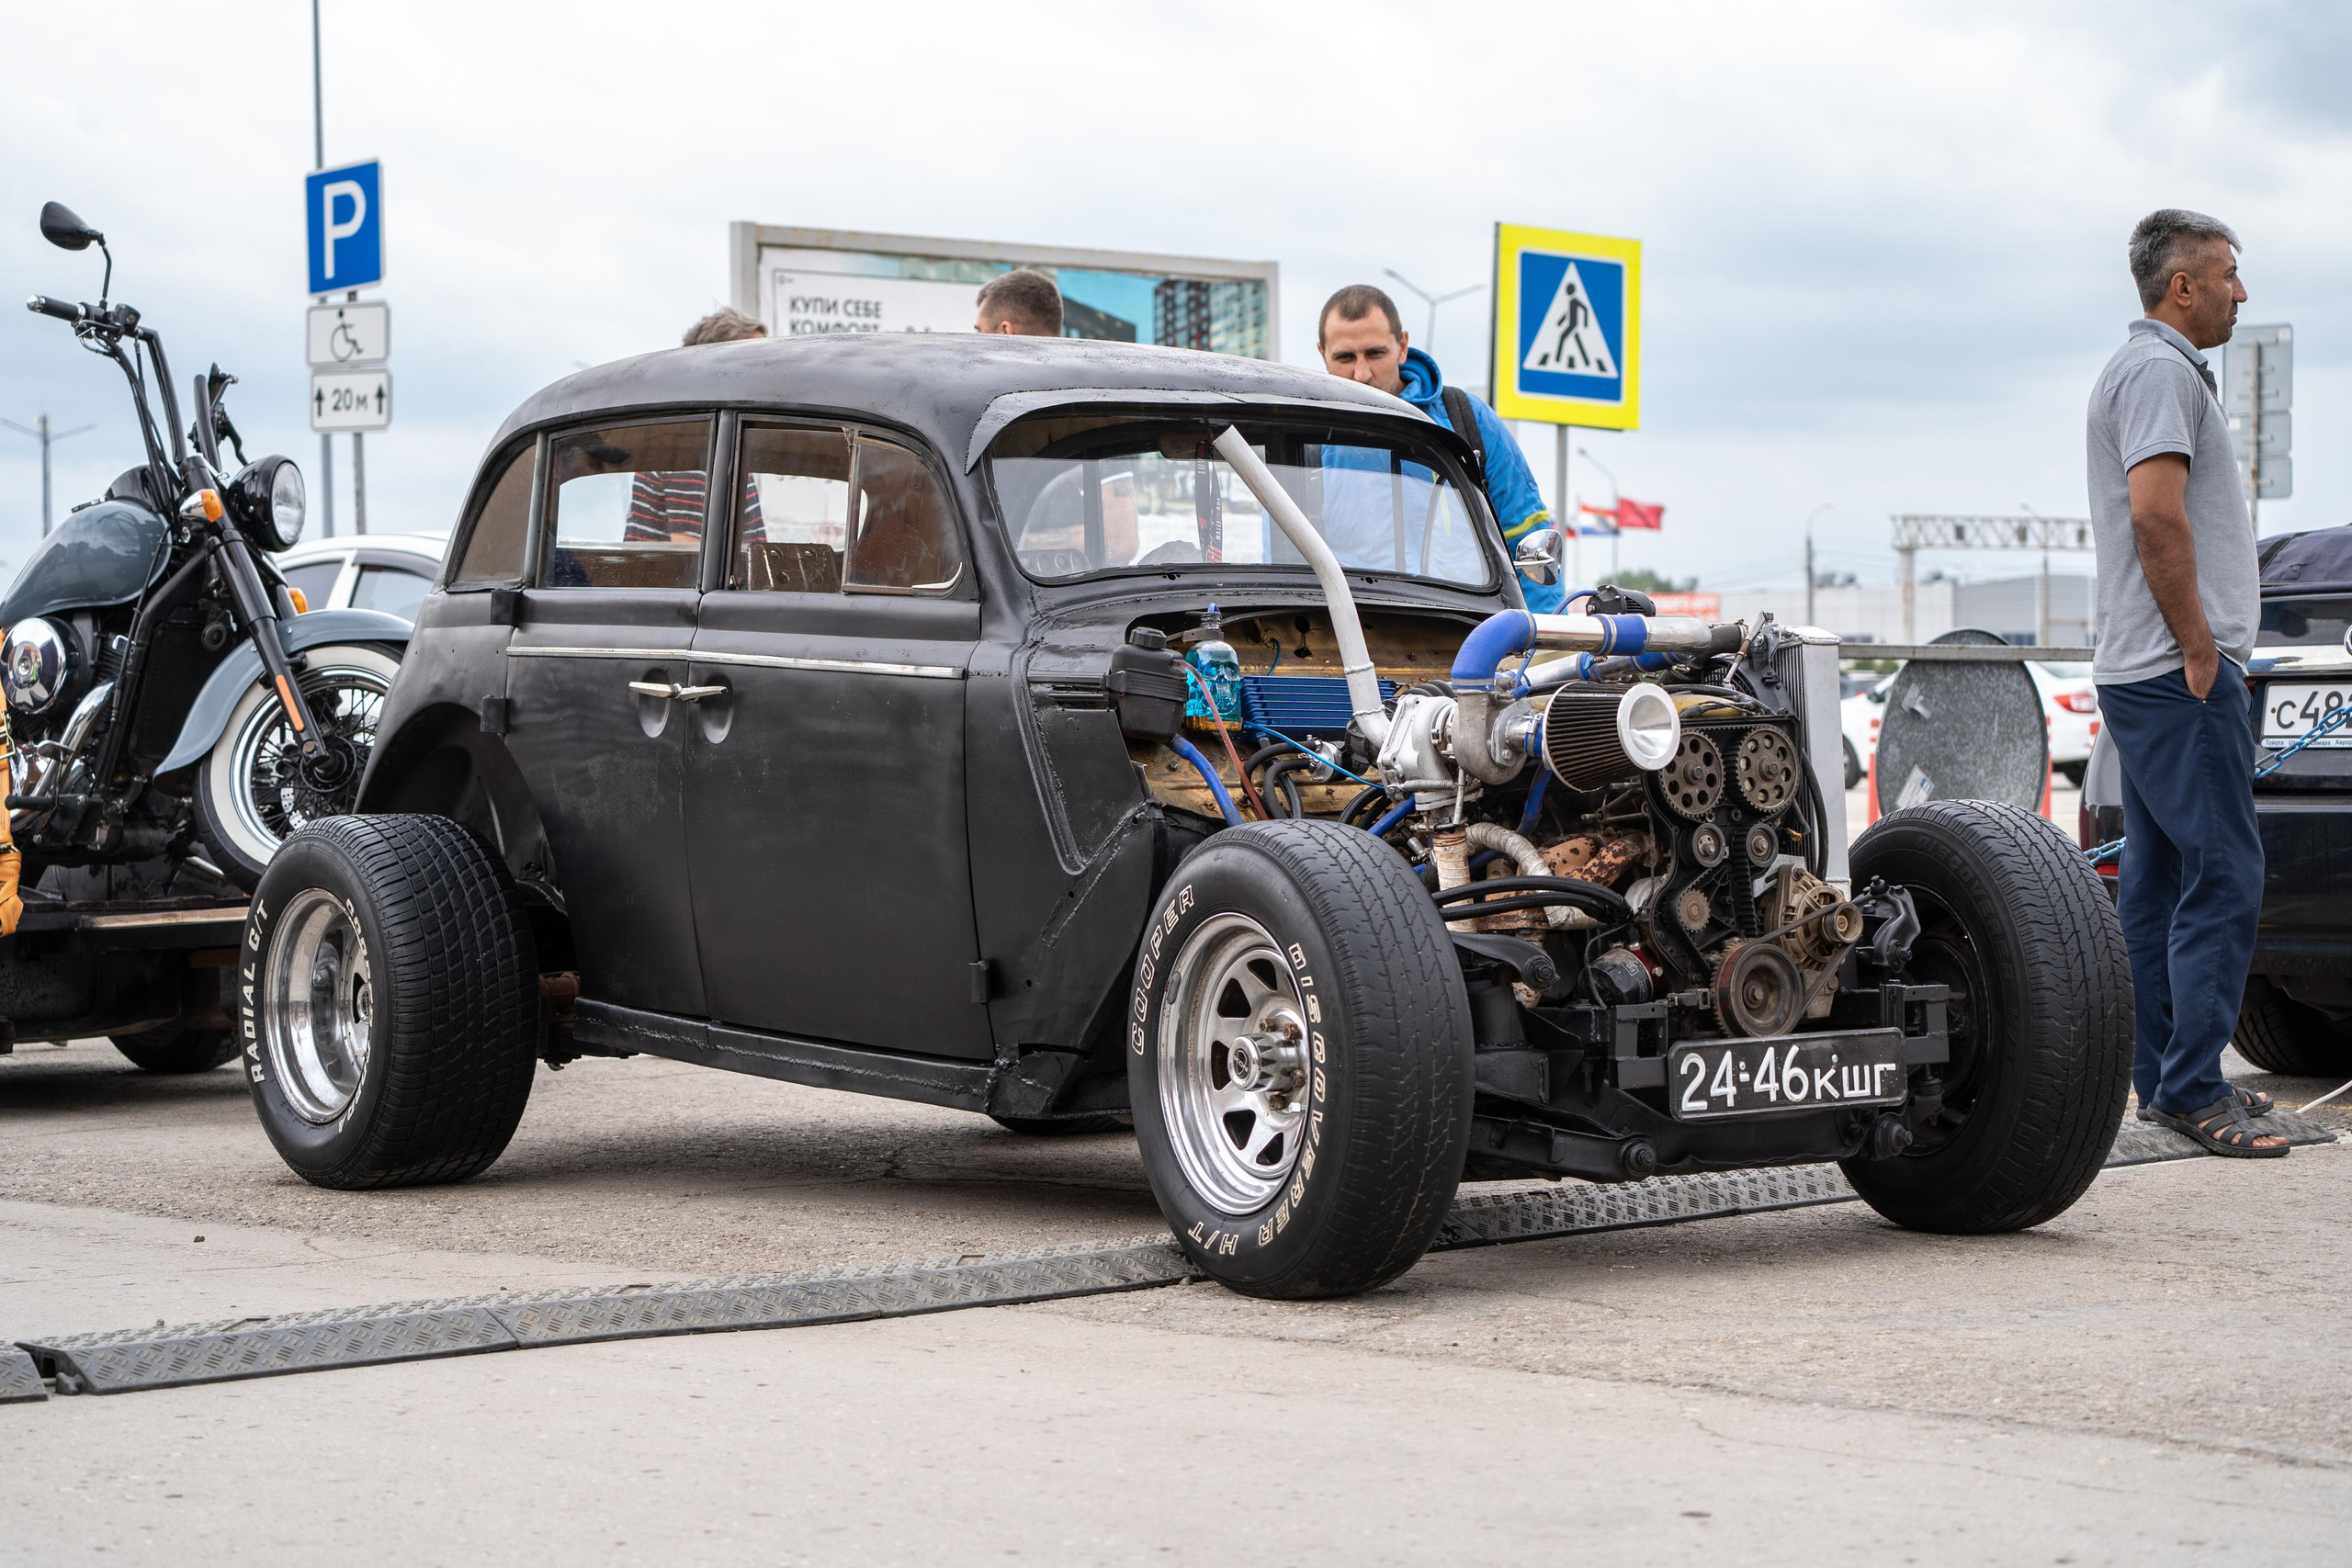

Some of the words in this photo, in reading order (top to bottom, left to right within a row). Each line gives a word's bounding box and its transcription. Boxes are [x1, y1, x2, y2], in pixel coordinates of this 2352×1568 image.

[322, 179, 367, 280] P
[789, 296, 839, 316] КУПИ
[842, 299, 882, 319] СЕБЕ
[332, 388, 353, 412] 20
[248, 898, 268, 953] G/T
[1131, 885, 1195, 1055] COOPER
[243, 962, 266, 1084] RADIAL
[1258, 942, 1326, 1247] DISCOVERER
[1187, 1220, 1239, 1256] H/T
